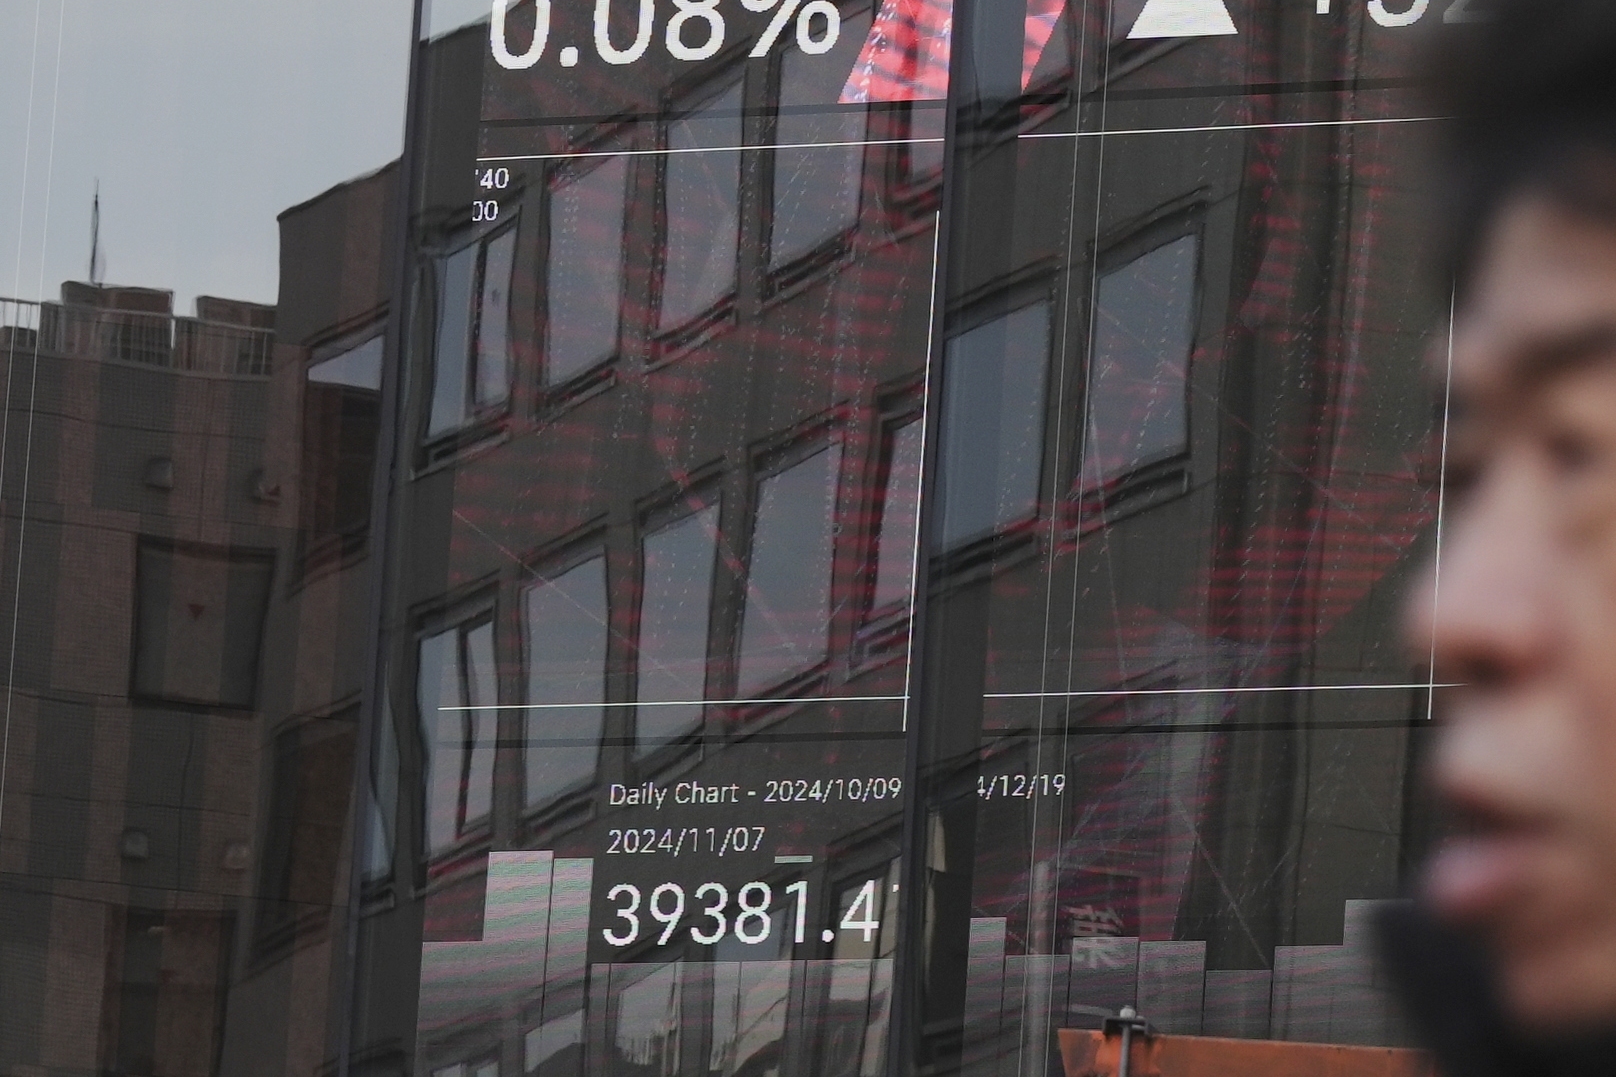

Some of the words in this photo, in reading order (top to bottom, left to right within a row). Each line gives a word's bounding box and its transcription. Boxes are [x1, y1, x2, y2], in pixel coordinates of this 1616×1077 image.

[475, 167, 510, 190] 40
[609, 780, 667, 811] Daily
[674, 780, 740, 805] Chart
[763, 777, 902, 804] 2024/10/09
[605, 825, 766, 858] 2024/11/07
[602, 879, 900, 947] 39381.4
